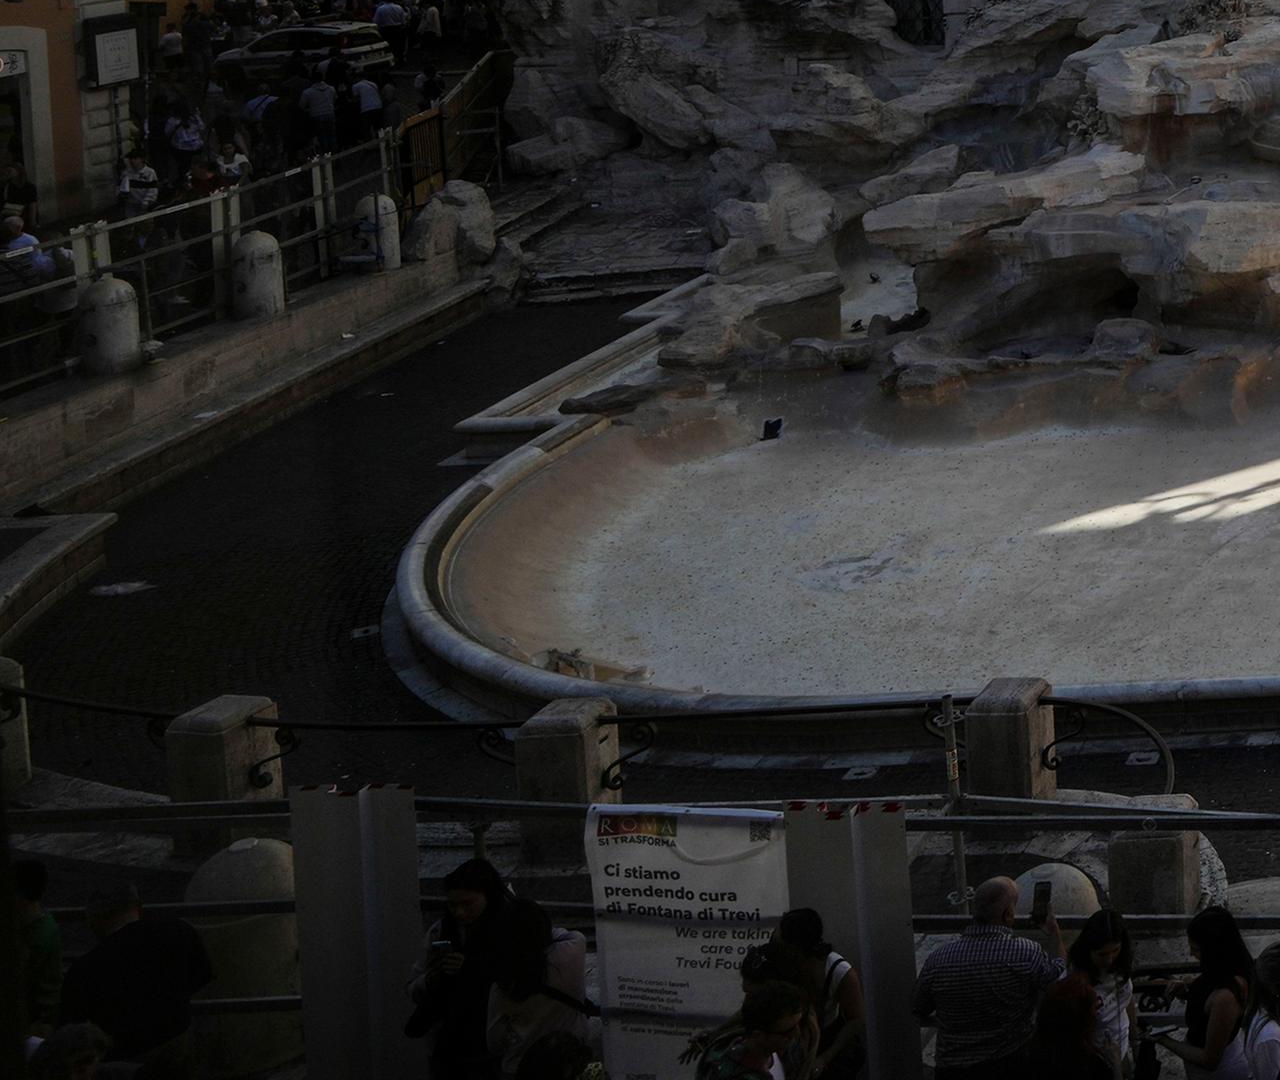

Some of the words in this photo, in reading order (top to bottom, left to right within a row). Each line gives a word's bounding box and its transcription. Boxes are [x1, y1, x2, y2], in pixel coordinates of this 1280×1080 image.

[600, 817, 673, 834] ROMA
[598, 837, 609, 846] SI
[611, 835, 677, 848] TRASFORMA
[604, 862, 620, 877] Ci
[624, 865, 681, 880] stiamo
[604, 884, 695, 900] prendendo
[699, 891, 737, 902] cura
[606, 901, 622, 914] di
[627, 903, 693, 920] Fontana
[697, 907, 714, 921] di
[717, 907, 761, 921] Trevi
[675, 926, 698, 938] We
[702, 929, 727, 939] are
[700, 944, 733, 954] care
[676, 956, 710, 969] Trevi
